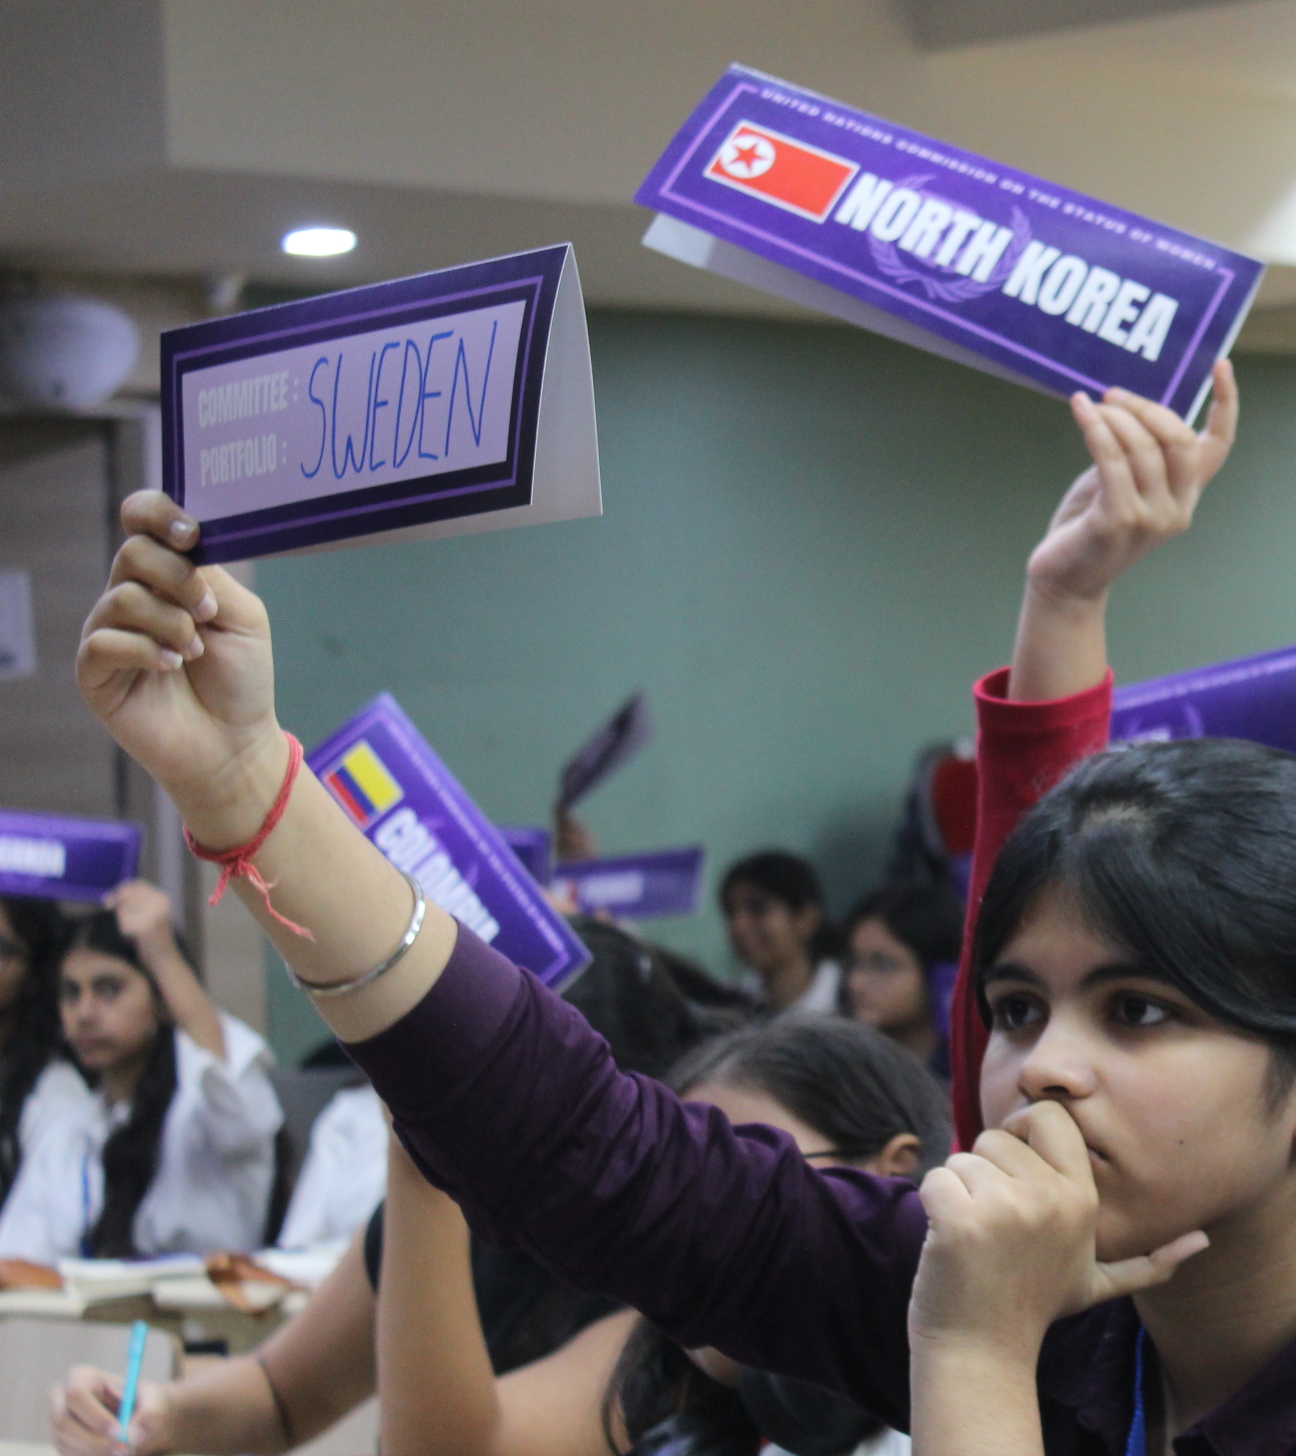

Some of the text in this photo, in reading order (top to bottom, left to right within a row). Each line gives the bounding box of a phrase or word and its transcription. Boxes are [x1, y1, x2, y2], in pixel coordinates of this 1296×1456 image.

[761, 88, 821, 117] UNITED
[822, 111, 893, 145] NATIONS
[896, 139, 998, 184] COMMISSION
[1000, 178, 1026, 195] ON
[1028, 188, 1061, 209] THE
[1063, 202, 1127, 234] STATUS
[1155, 237, 1216, 270] WOMEN
[833, 172, 1180, 362] NORTH KOREA
[199, 370, 289, 428] COMMITTEE
[200, 434, 278, 487] PORTFOLIO
[301, 320, 498, 479] SWEDEN
